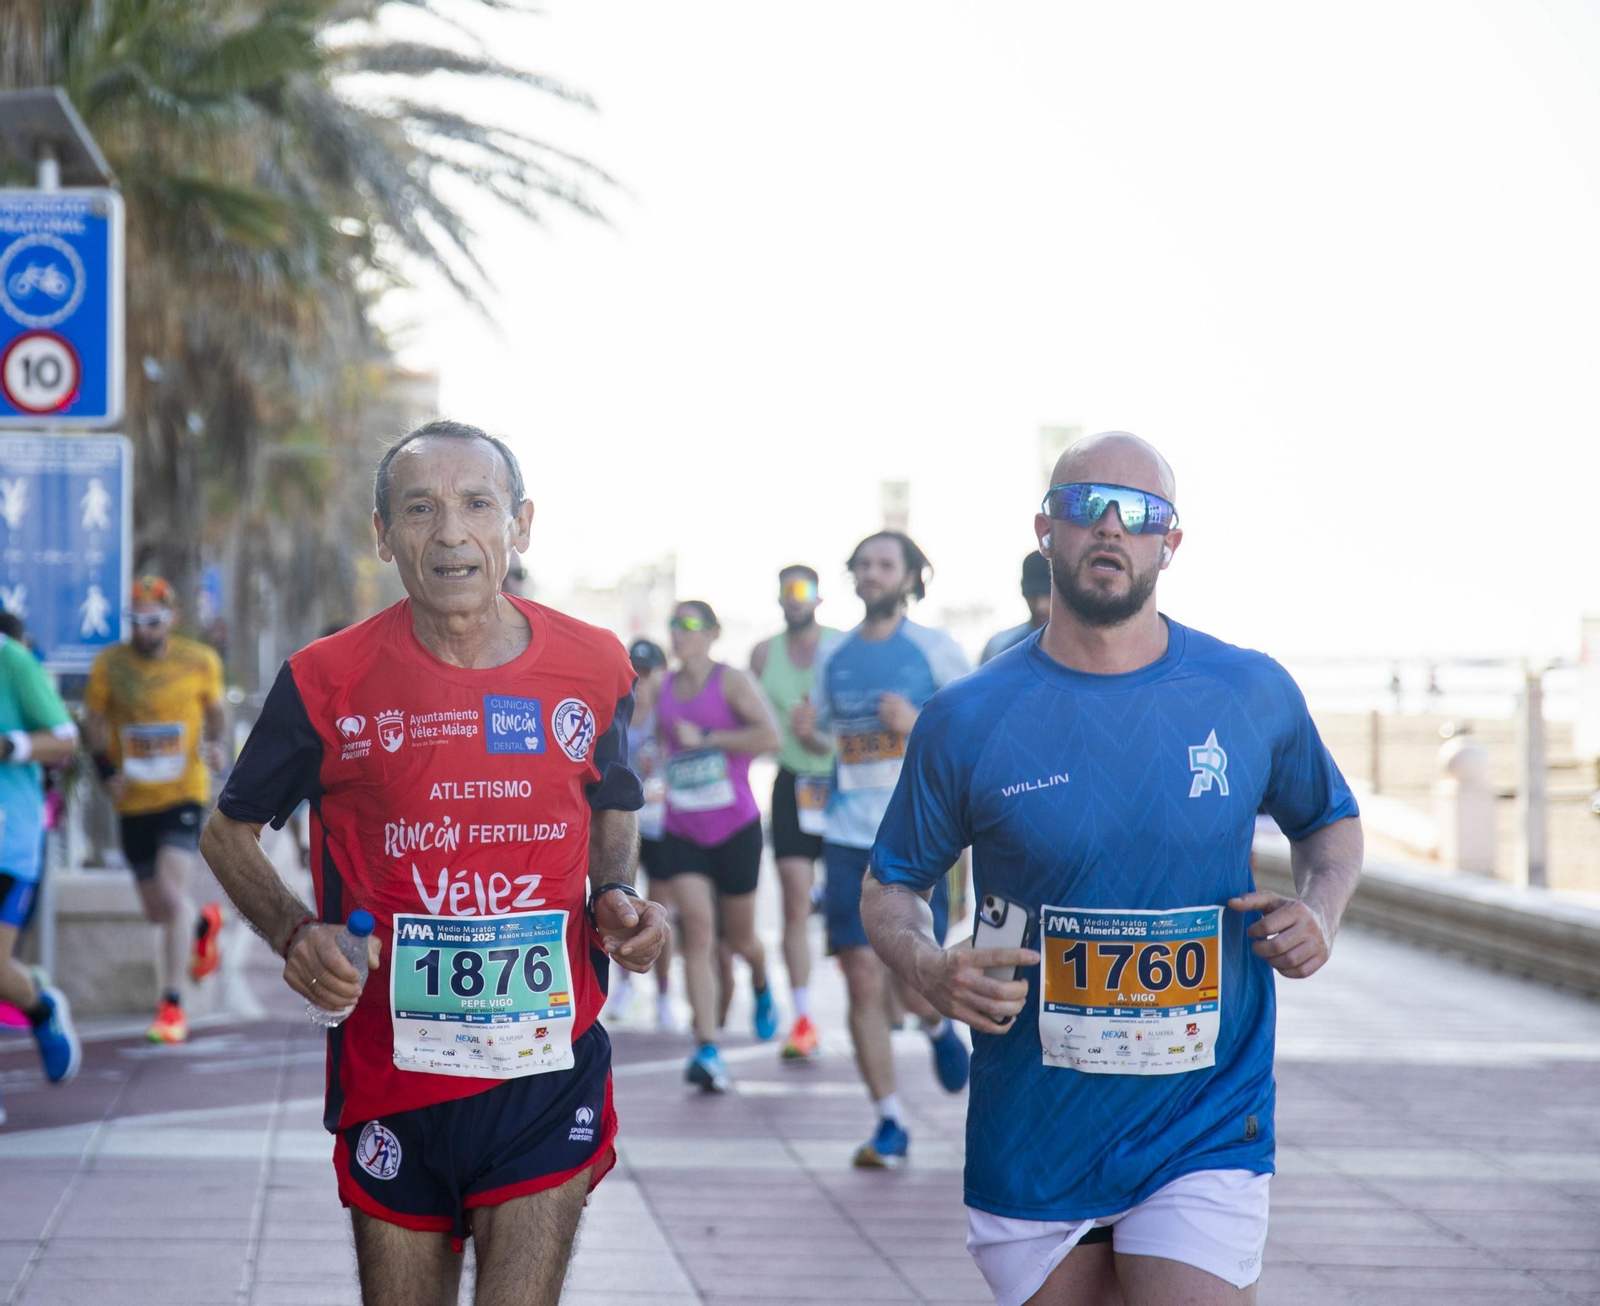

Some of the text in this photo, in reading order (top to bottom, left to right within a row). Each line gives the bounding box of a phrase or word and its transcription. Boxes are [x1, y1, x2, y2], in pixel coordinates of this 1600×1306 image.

[20, 354, 62, 389] 10
[490, 699, 535, 711] CLINICAS
[410, 709, 479, 728] Ayuntamiento
[410, 722, 478, 739] Vélez-Málaga
[493, 742, 525, 751] DENTAL
[429, 780, 532, 800] ATLETISMO
[1001, 773, 1069, 797] WILLIN
[469, 822, 568, 843] FERTILIDAD
[412, 862, 546, 916] Vélez
[437, 925, 461, 933] Medio
[463, 925, 497, 933] Maratón
[1112, 919, 1148, 927] Maratón
[437, 932, 496, 942] Almería 2025
[1083, 926, 1147, 936] Almería 2025
[414, 945, 554, 998] 1876
[1063, 940, 1207, 991] 1760
[460, 998, 514, 1008] PEPE VIGO
[1117, 993, 1156, 1002] A. VIGO
[455, 1034, 481, 1043] NEXAL
[1101, 1029, 1129, 1039] NEXAL
